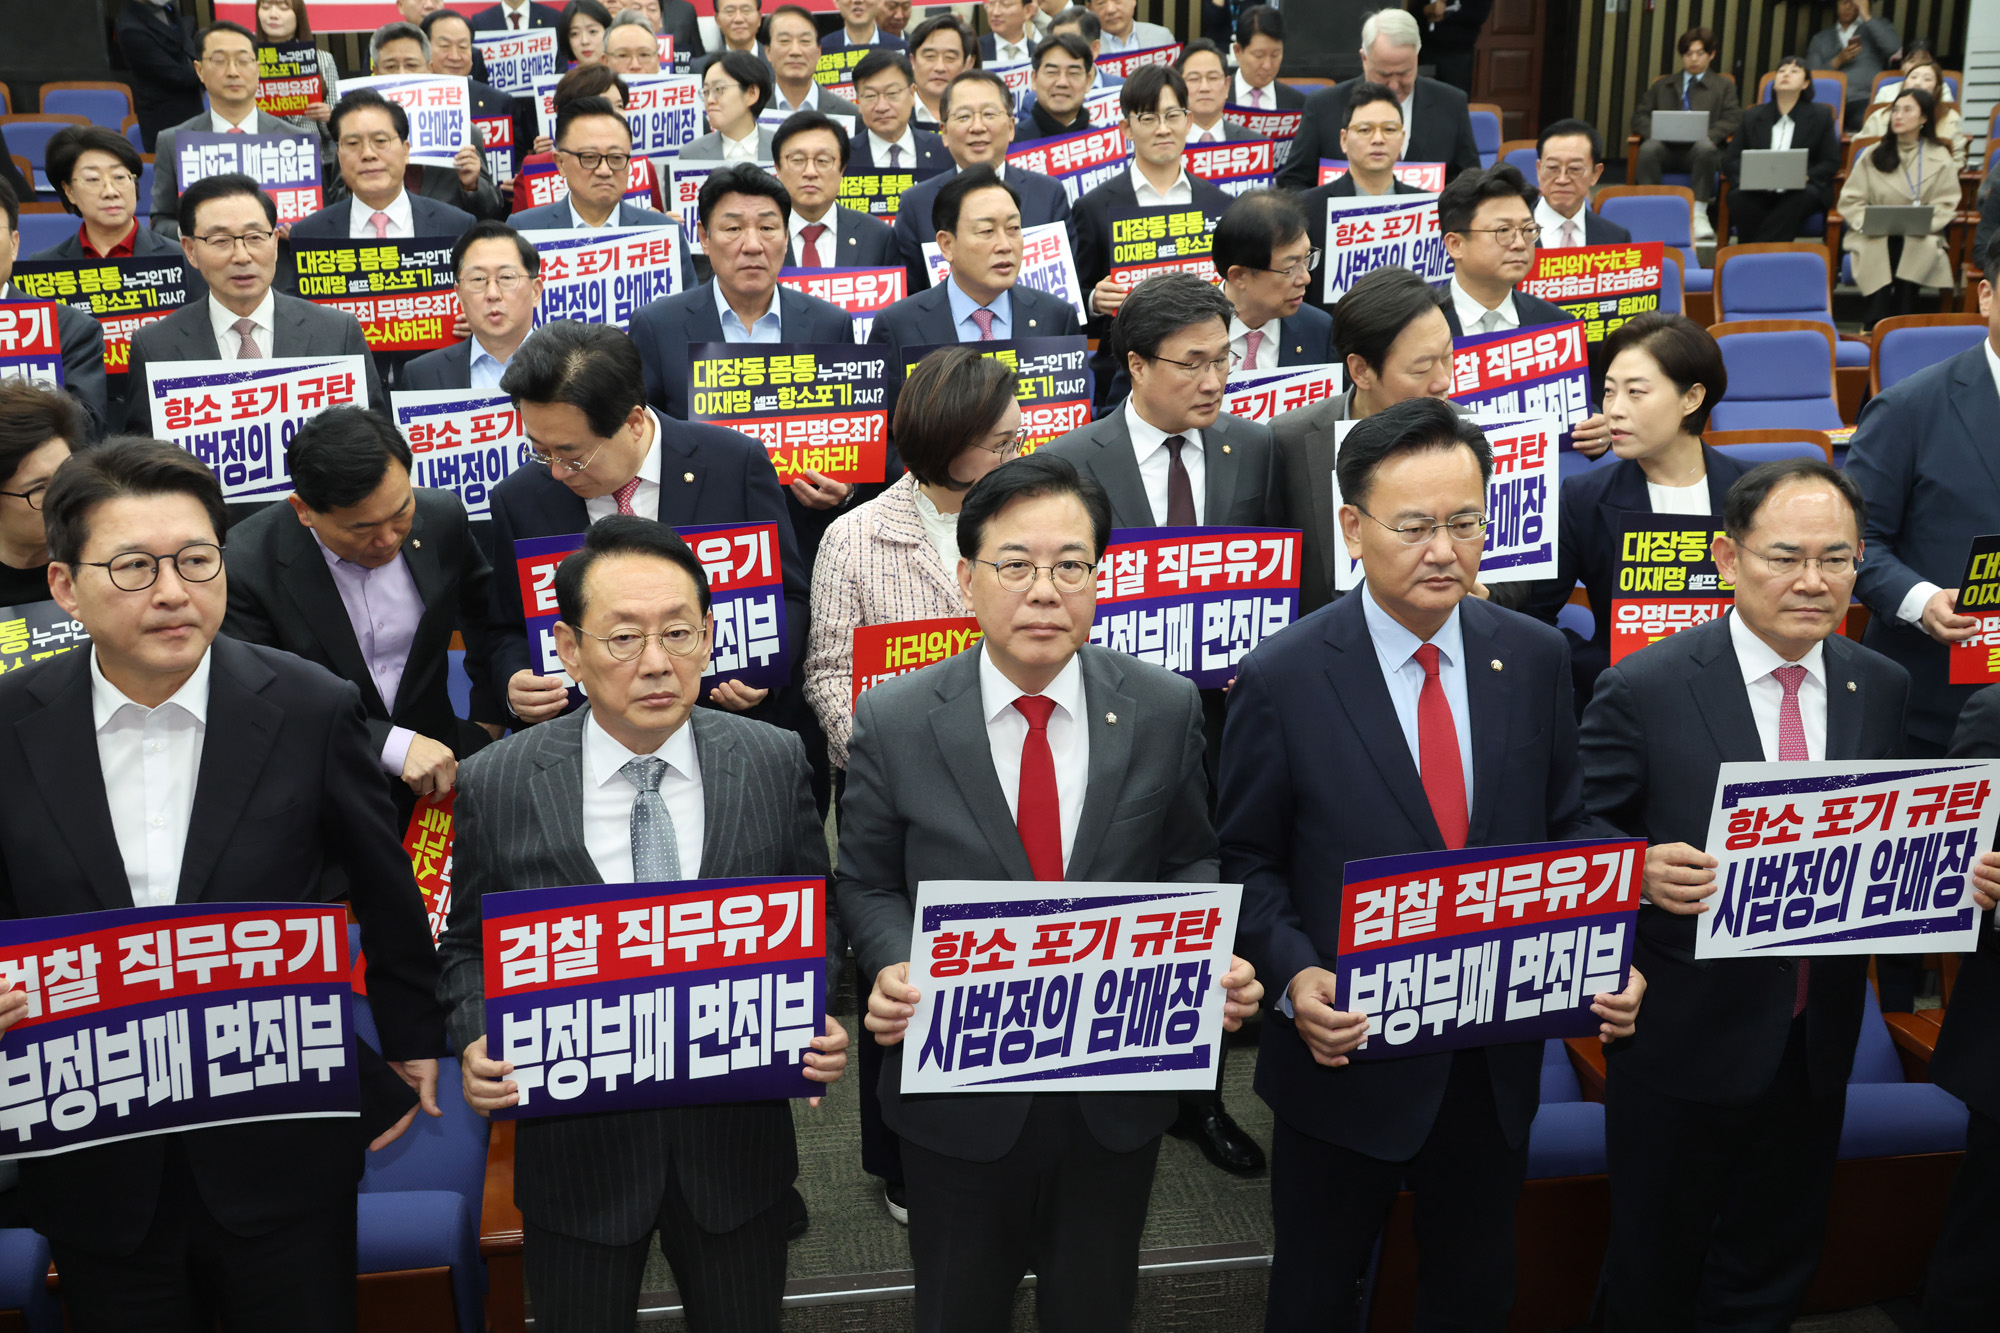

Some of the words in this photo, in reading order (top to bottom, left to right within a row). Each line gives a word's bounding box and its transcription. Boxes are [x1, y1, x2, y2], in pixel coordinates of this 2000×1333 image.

[500, 40, 523, 58] 포기
[528, 36, 552, 53] 규탄
[486, 59, 517, 88] 법정의
[428, 86, 463, 106] 규탄
[662, 85, 696, 106] 규탄
[418, 109, 463, 147] 암매장
[476, 119, 510, 145] 유기
[652, 108, 696, 148] 암매장
[1050, 129, 1123, 170] 직무유기
[1193, 144, 1270, 177] 직무유기
[680, 182, 701, 202] 항
[881, 174, 914, 195] 몸통
[1113, 215, 1167, 242] 대장동
[1168, 211, 1204, 236] 몸통
[1336, 221, 1375, 247] 항소
[1381, 213, 1422, 240] 포기
[296, 249, 357, 274] 대장동
[358, 246, 400, 271] 몸통
[401, 248, 453, 268] 누구인가
[577, 246, 619, 276] 포기
[627, 238, 671, 269] 규탄
[1114, 241, 1156, 263] 이재명
[1158, 244, 1176, 258] 셀프
[1175, 233, 1213, 256] 항소포
[78, 266, 122, 294] 몸통
[123, 267, 183, 289] 누구인가?
[299, 275, 347, 295] 이재명
[349, 280, 370, 293] 셀프
[367, 268, 432, 292] 항소포기
[433, 271, 457, 286] 지시
[807, 272, 902, 310] 직무유기
[1597, 265, 1660, 294] 유명무죄
[90, 288, 158, 313] 항소포기
[159, 290, 185, 306] 지시?
[377, 291, 460, 322] 무명유죄?
[1599, 300, 1618, 314] 셀프
[1617, 294, 1657, 316] 이재명
[361, 318, 443, 345] 수사하라!
[1583, 319, 1604, 343] 몸
[693, 357, 766, 388] 대장동
[769, 354, 817, 385] 몸통
[817, 359, 885, 381] 누구인가?
[1019, 351, 1085, 375] 누구인가?
[1449, 351, 1480, 396] 찰
[1486, 326, 1582, 381] 직무유기
[164, 394, 222, 430] 항소
[231, 383, 288, 420] 포기
[297, 372, 355, 409] 규탄
[694, 390, 751, 415] 이재명
[754, 395, 778, 411] 셀프
[777, 383, 852, 410] 항소포기
[854, 388, 884, 404] 지시?
[1016, 375, 1054, 400] 포기
[1055, 378, 1085, 395] 지시?
[1017, 404, 1087, 437] 명유죄?
[1230, 390, 1276, 420] 포기
[408, 420, 462, 454] 항소
[470, 409, 523, 444] 포기
[785, 414, 884, 447] 무명유죄?
[770, 446, 858, 477] 수사하라!
[1492, 432, 1548, 475] 규탄
[694, 530, 773, 586] 유기
[1622, 531, 1708, 562] 대장동
[1157, 538, 1294, 589] 직무유기
[1620, 567, 1687, 591] 이재명
[1688, 574, 1717, 590] 셀프
[32, 620, 91, 647] 누구인
[701, 594, 780, 677] 죄부
[1201, 597, 1291, 671] 면죄부
[1725, 803, 1804, 850] 항소
[1812, 790, 1900, 839] 포기
[1906, 779, 1991, 828] 규탄
[1353, 877, 1444, 947] 검찰
[1455, 848, 1635, 924] 직무유기
[1711, 842, 1862, 938] 사법정의
[1861, 827, 1978, 919] 암매장
[118, 916, 338, 991] 직무유기
[500, 914, 602, 989] 검찰
[617, 888, 814, 967] 직무유기
[930, 928, 1016, 978] 항소
[1028, 916, 1121, 967] 포기
[1131, 907, 1222, 957] 규탄
[1348, 940, 1501, 1050] 부정부패
[1505, 922, 1626, 1022] 면죄부
[918, 972, 1083, 1073] 사법정의
[1087, 959, 1212, 1055] 암매장
[502, 986, 675, 1107] 부정부패
[689, 970, 815, 1080] 면죄부
[0, 1008, 194, 1142] 부정부패
[204, 994, 345, 1098] 면죄부
